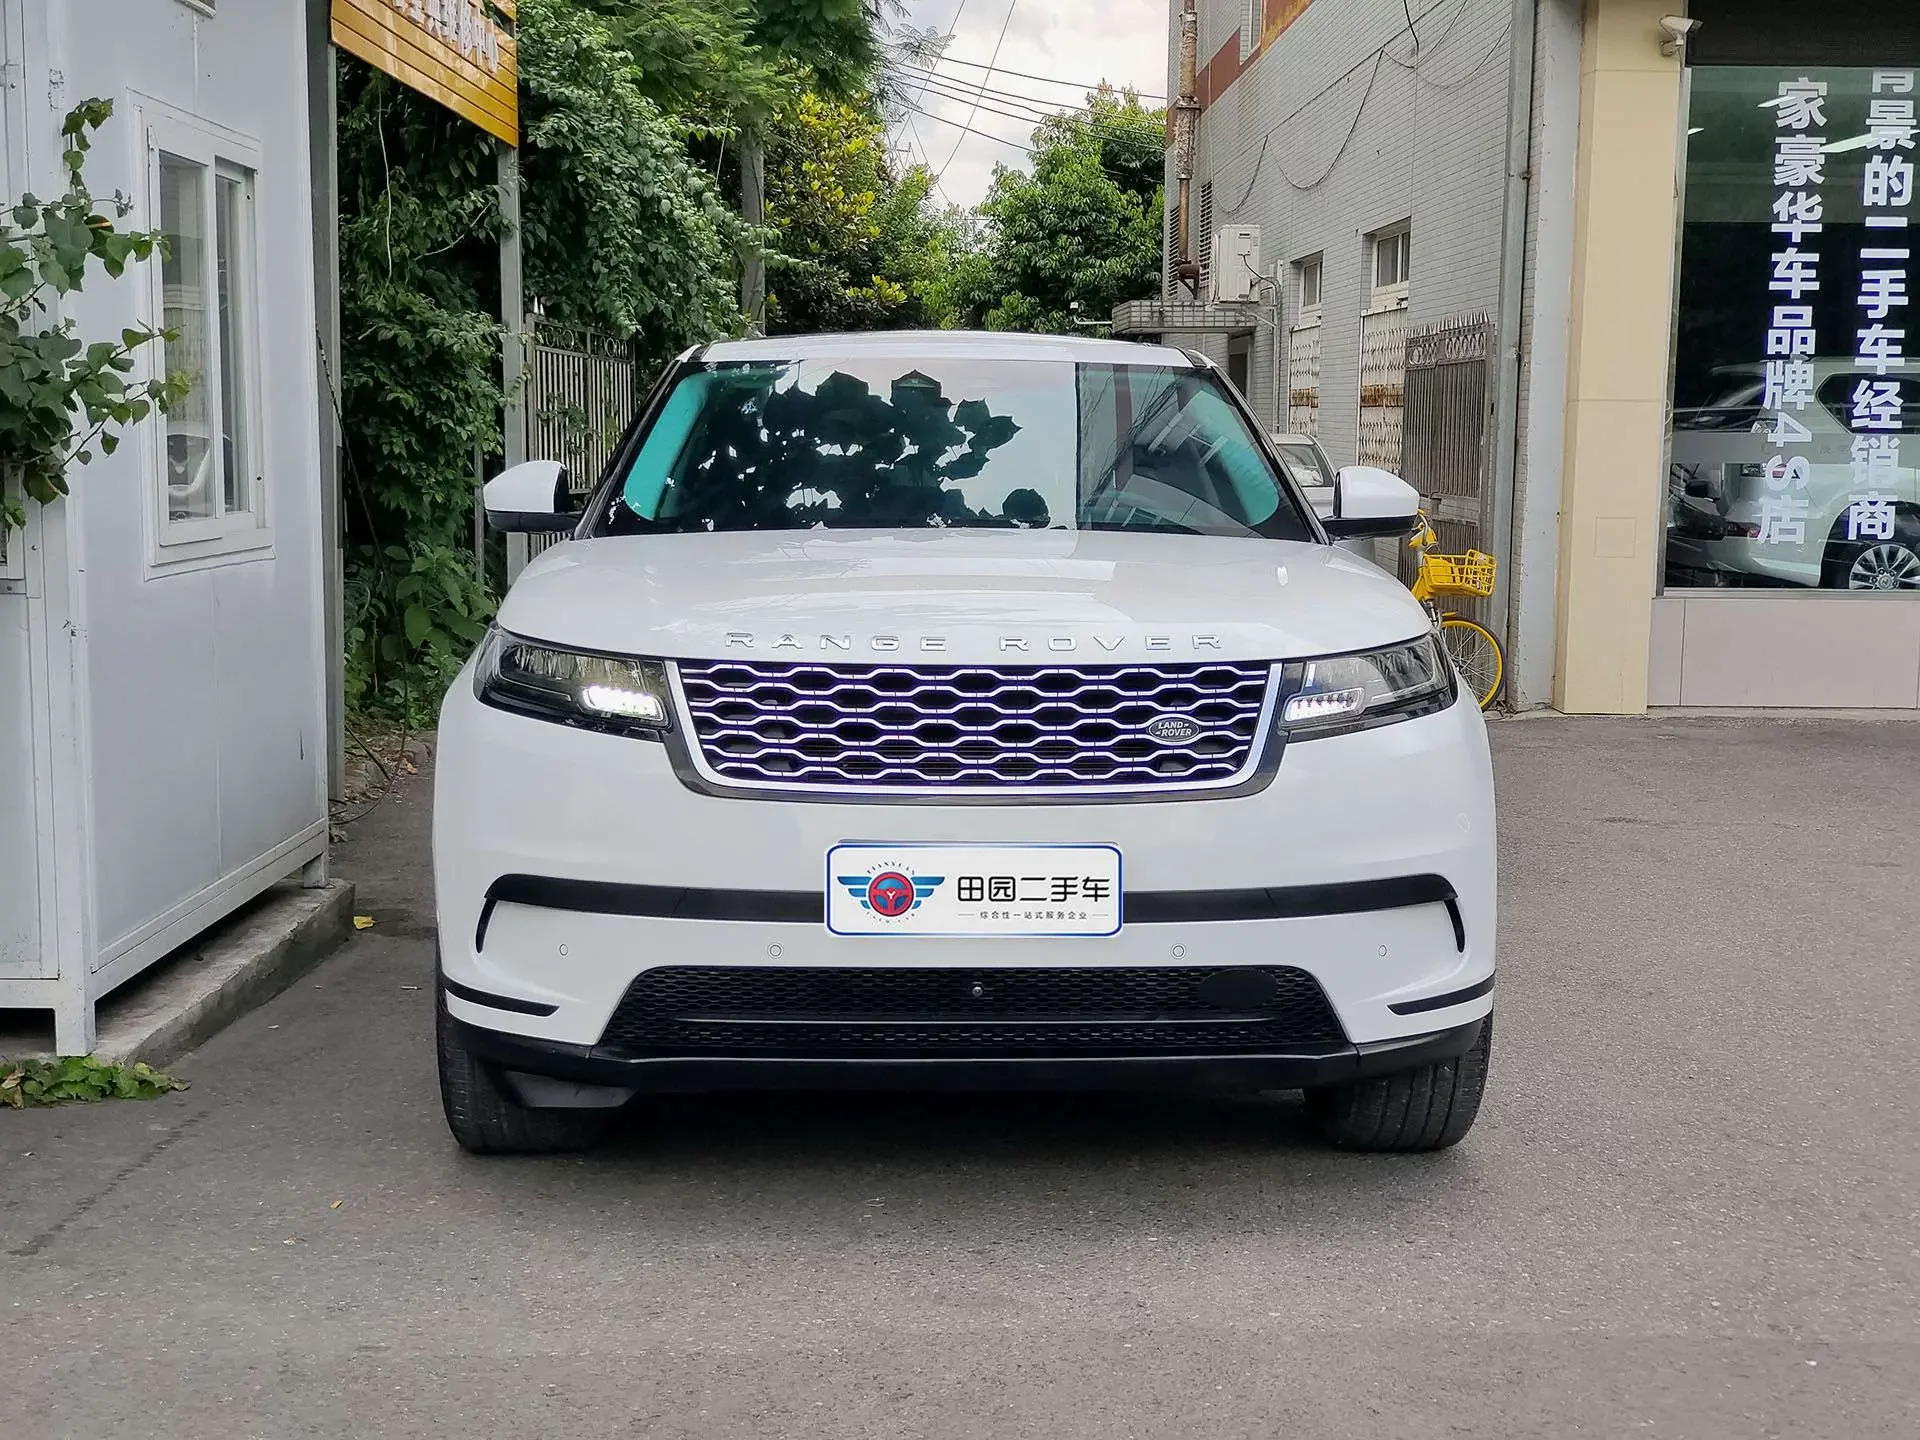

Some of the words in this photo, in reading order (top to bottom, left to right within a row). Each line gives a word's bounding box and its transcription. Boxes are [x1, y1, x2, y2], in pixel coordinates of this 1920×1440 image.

[1757, 77, 1828, 545] 家豪华车品牌4S店
[725, 632, 948, 652] RANGE
[998, 634, 1223, 652] ROVER
[1158, 721, 1184, 729] LAND
[1161, 728, 1193, 737] ROVER
